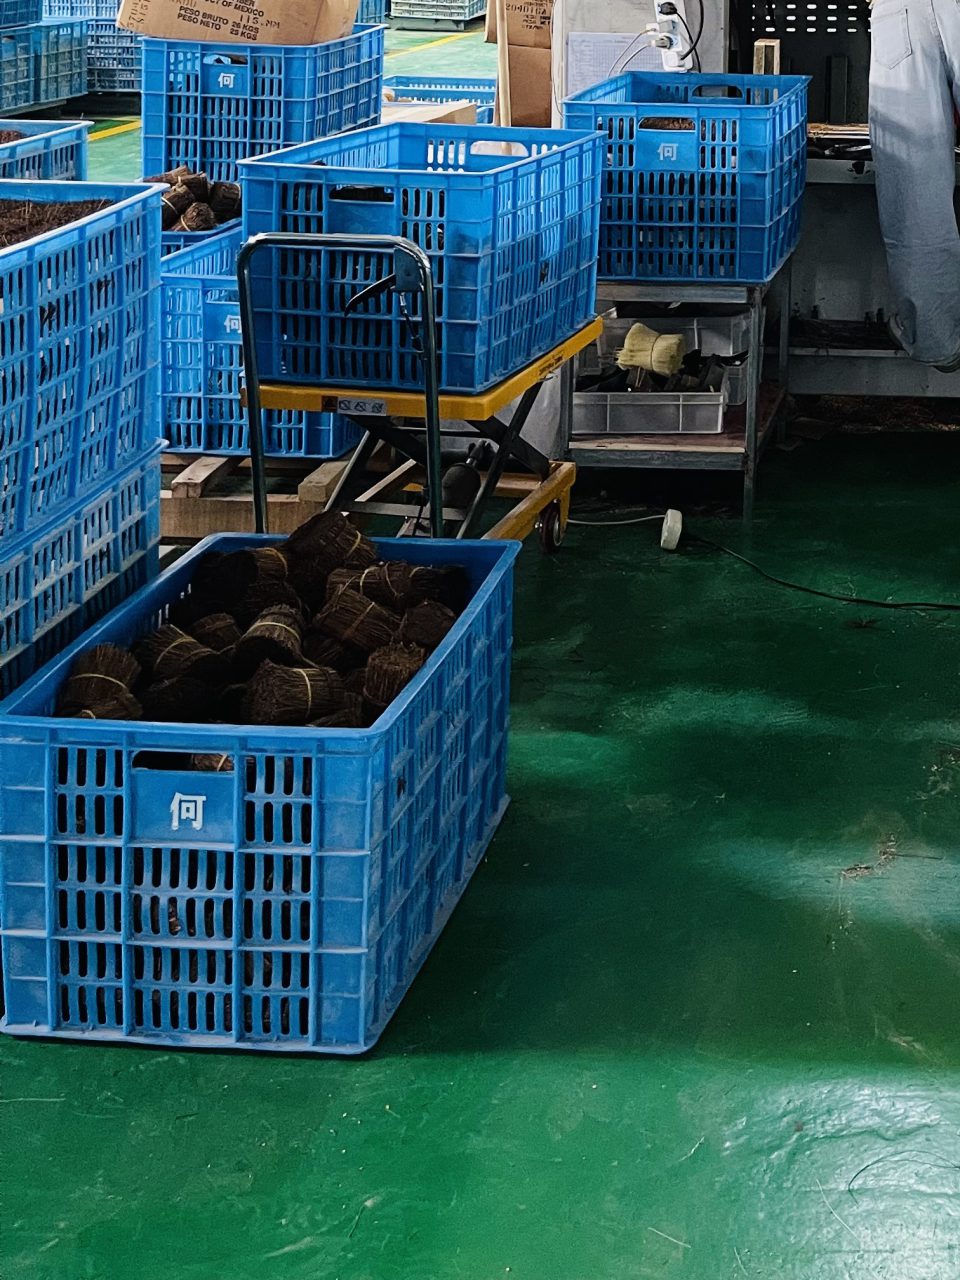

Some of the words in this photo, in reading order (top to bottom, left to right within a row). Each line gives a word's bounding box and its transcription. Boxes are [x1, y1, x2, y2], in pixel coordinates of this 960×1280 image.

[221, 0, 233, 8] OF
[234, 3, 265, 17] MEXICO
[177, 12, 198, 24] PESO
[199, 19, 221, 31] NETO
[230, 28, 239, 36] 25
[240, 30, 258, 40] KGS
[179, 5, 200, 17] PESO
[201, 12, 229, 25] BRUTO
[231, 21, 241, 29] 26
[242, 23, 260, 34] KGS
[218, 73, 235, 88] 何
[657, 143, 679, 161] 何
[224, 314, 243, 334] 何
[169, 791, 207, 831] 何
